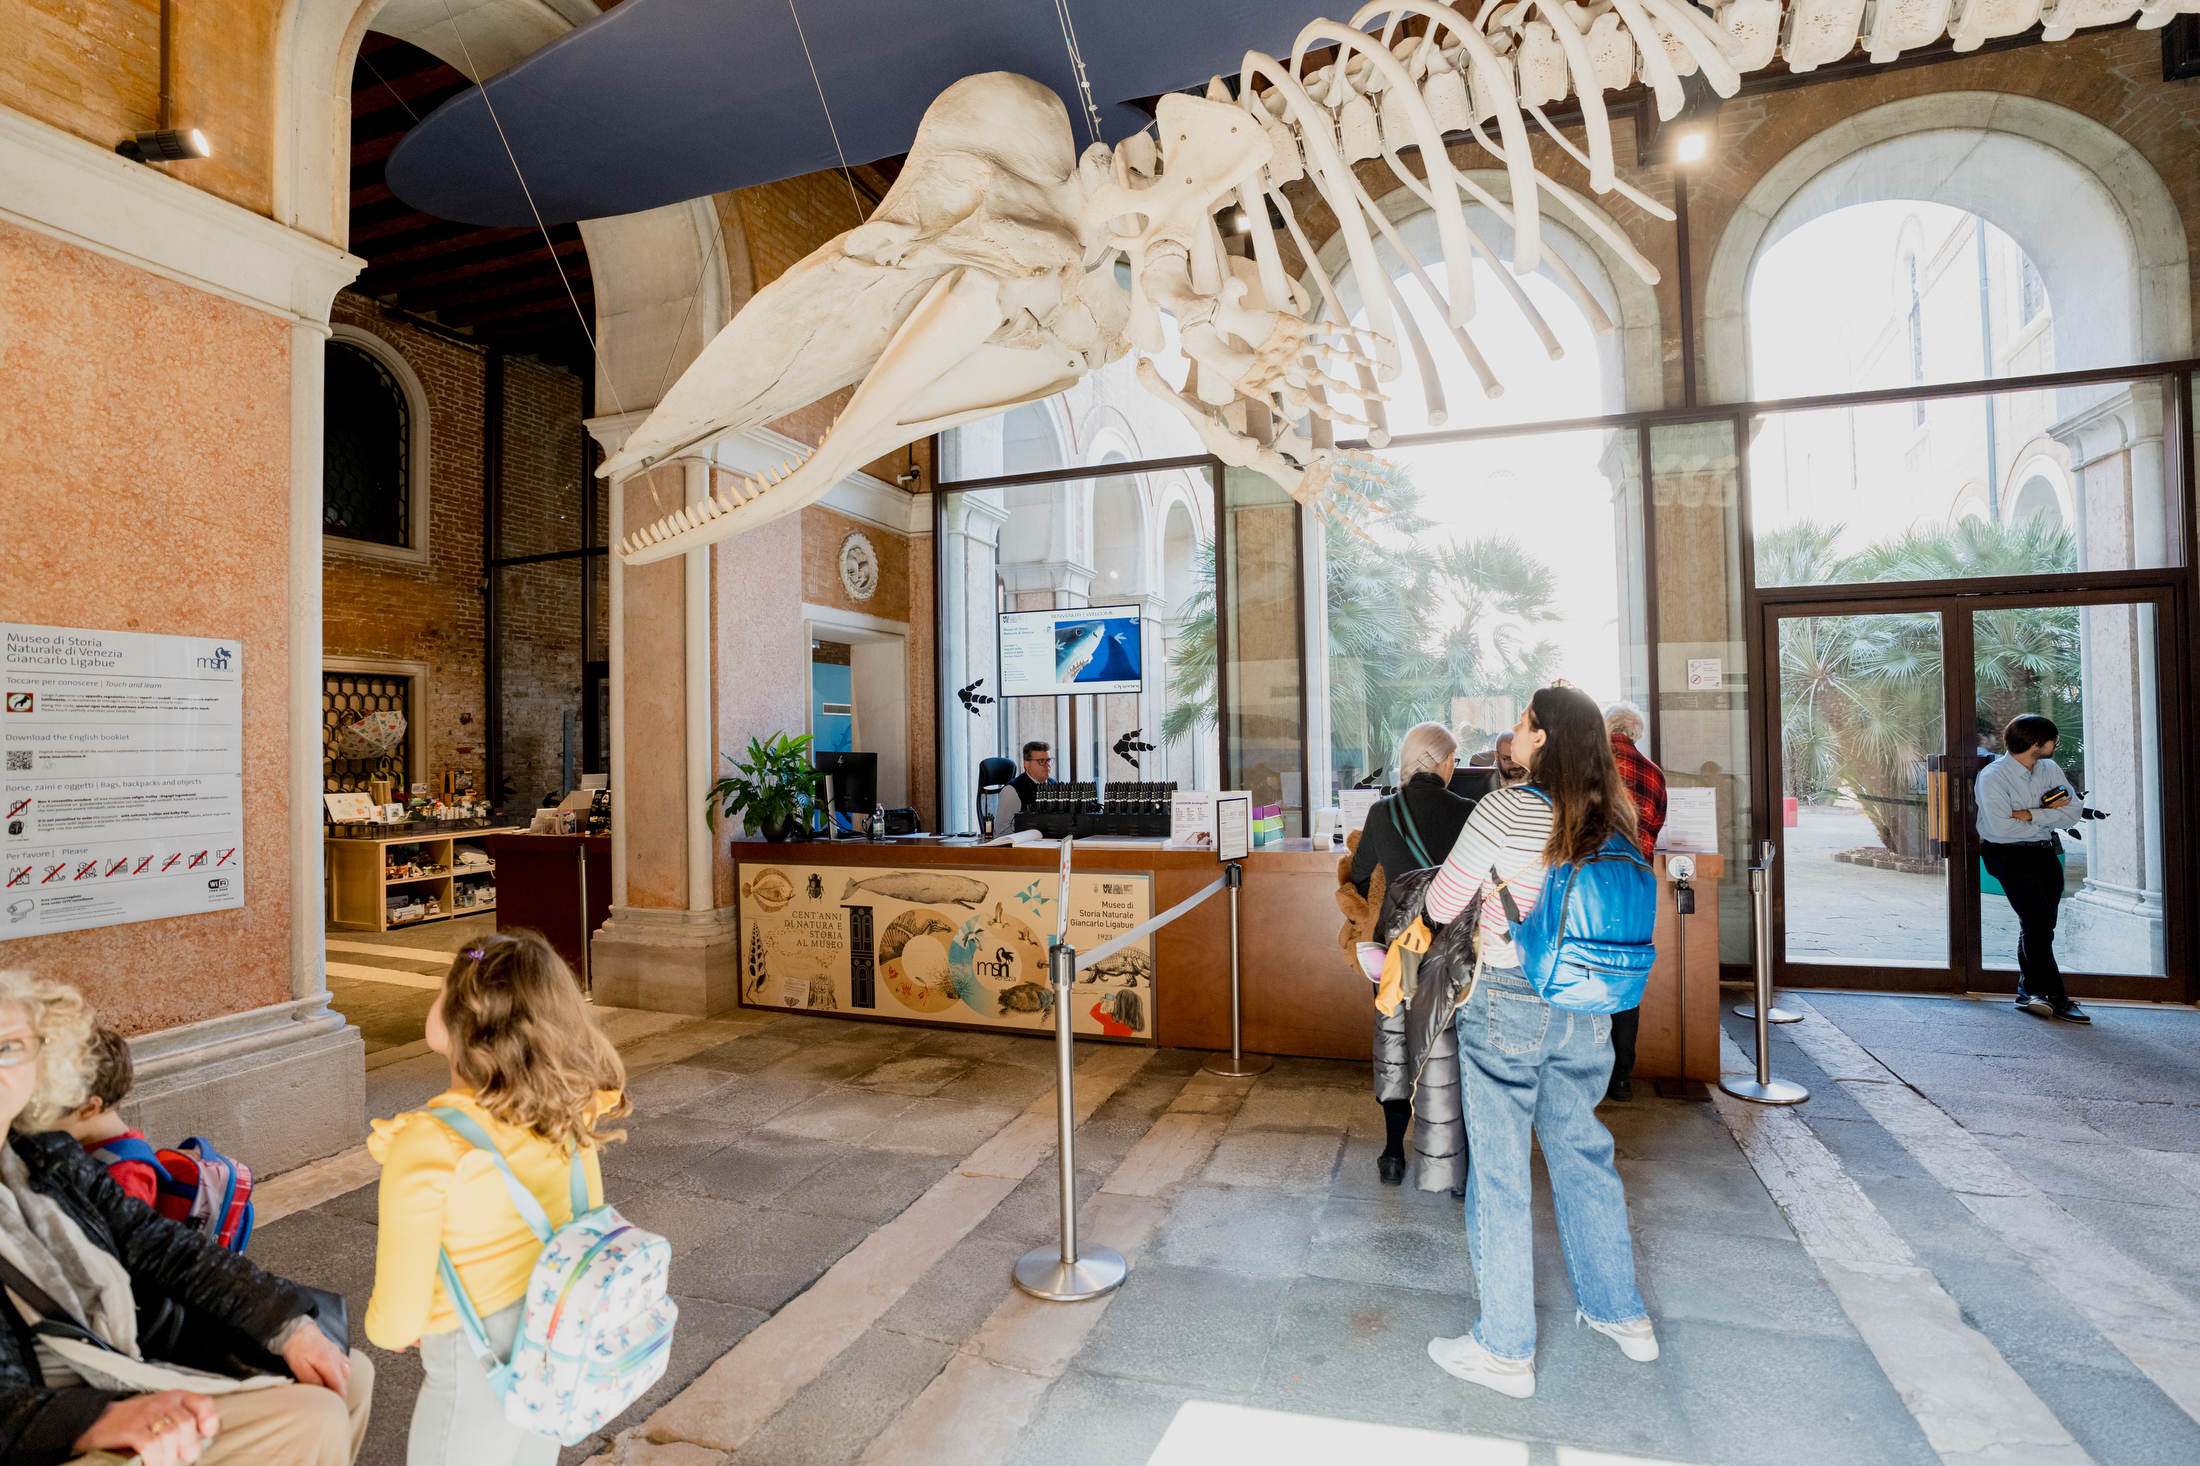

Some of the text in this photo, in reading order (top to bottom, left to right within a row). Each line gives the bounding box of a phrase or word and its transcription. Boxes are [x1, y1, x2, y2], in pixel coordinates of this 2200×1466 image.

[7, 632, 102, 647] Museo di Storia
[7, 643, 123, 658] Naturale di Venezia
[7, 653, 115, 669] Giancarlo Ligabue
[7, 677, 40, 686] Toccare
[41, 679, 56, 687] per
[57, 679, 99, 687] conoscere
[105, 680, 128, 688] Touch
[129, 680, 143, 688] and
[144, 681, 163, 689] learn
[5, 733, 130, 743] Download the English booklet
[5, 784, 33, 792] Borse,
[64, 782, 94, 792] oggetti
[100, 781, 121, 790] Bags,
[122, 780, 160, 788] backpacks
[177, 778, 202, 786] objects
[22, 851, 50, 859] favore
[62, 848, 88, 856] Please
[1101, 901, 1134, 909] Museo di
[791, 910, 842, 921] CENT'ANNI
[1079, 910, 1134, 919] Storia Naturale
[795, 921, 834, 930] NATURA
[837, 922, 843, 930] E
[1070, 919, 1134, 929] Giancarlo Ligabue
[809, 930, 843, 940] STORIA
[796, 939, 844, 949] AL MUSEO
[976, 961, 1010, 977] msn
